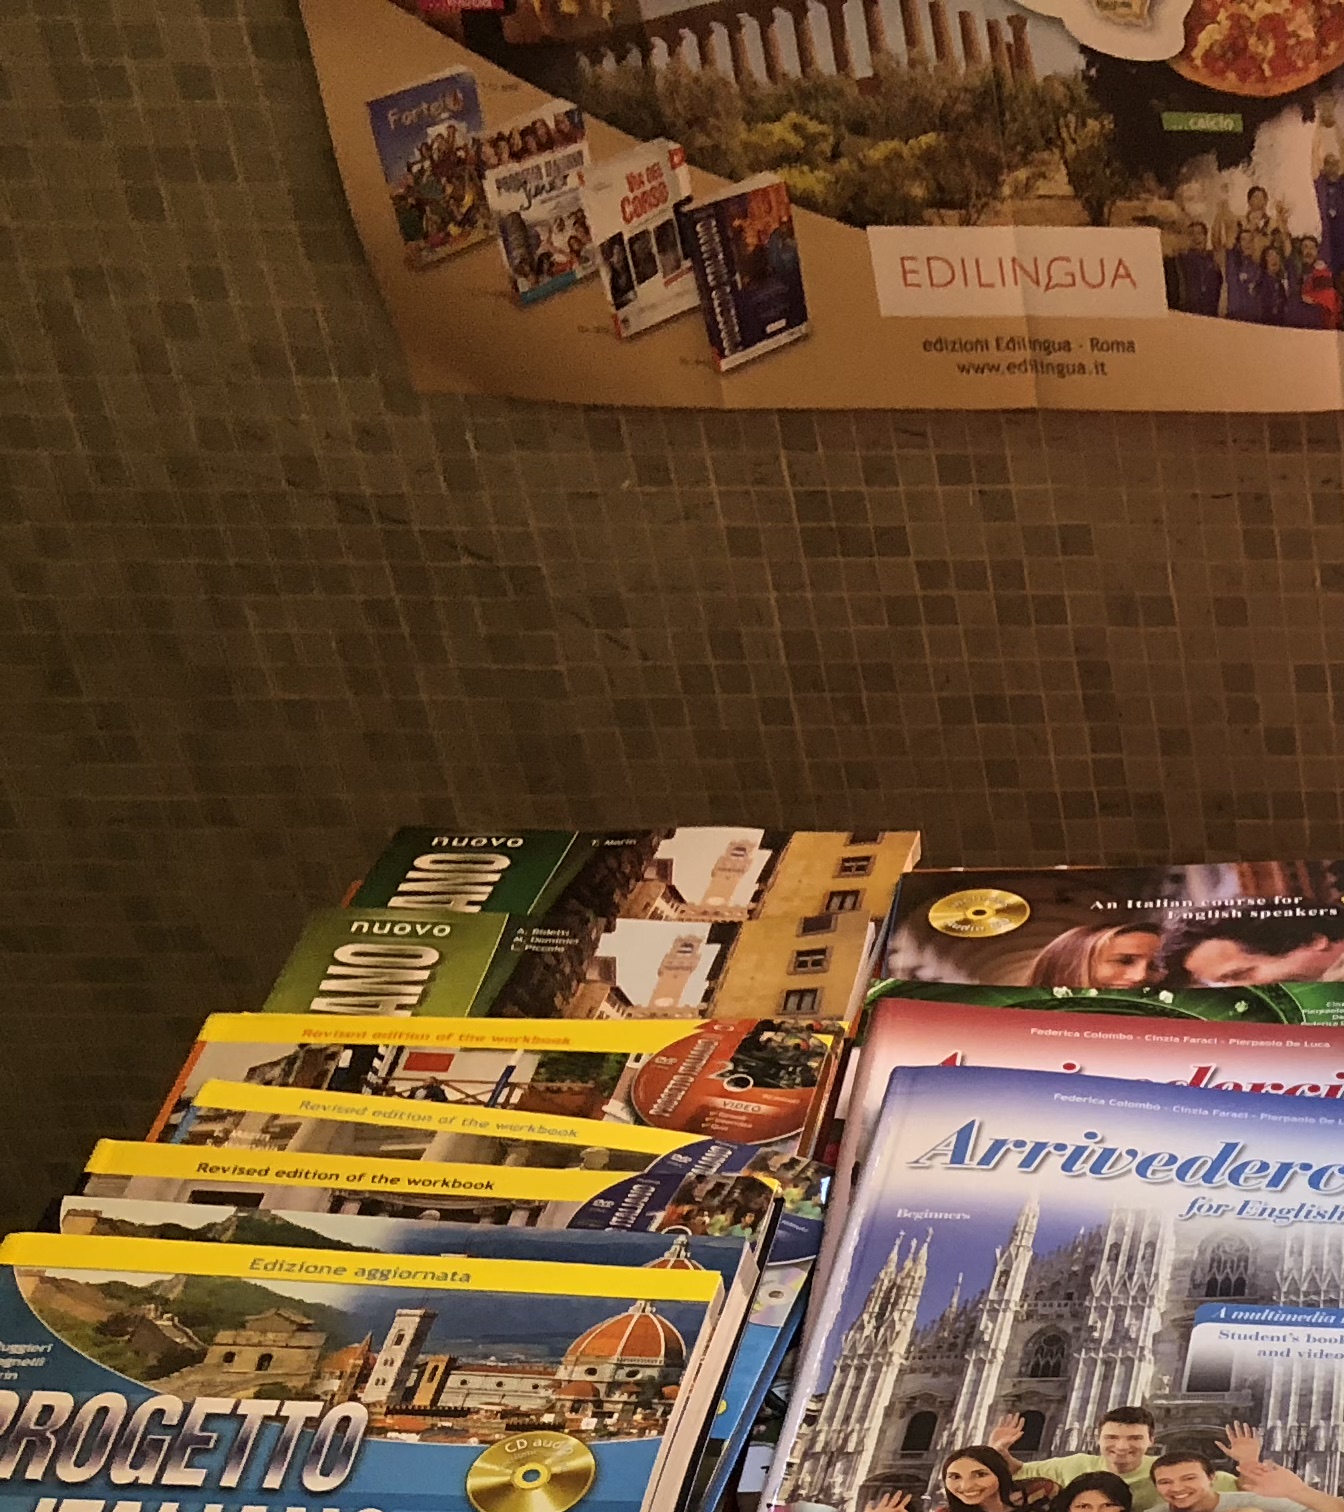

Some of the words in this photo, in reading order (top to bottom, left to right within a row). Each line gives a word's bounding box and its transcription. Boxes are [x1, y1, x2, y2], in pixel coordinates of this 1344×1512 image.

[900, 256, 1137, 292] EDILINGUA
[923, 337, 989, 353] edizioni
[995, 337, 1072, 355] Edilingua
[1090, 337, 1135, 354] Roma
[431, 835, 524, 848] nuovo
[1126, 896, 1191, 909] Italian
[1200, 896, 1268, 909] course
[1168, 907, 1245, 921] English
[1253, 906, 1337, 919] speakers
[350, 920, 452, 937] nuovo
[197, 1161, 271, 1180] Revised
[273, 1166, 340, 1184] edition
[345, 1168, 365, 1188] of
[369, 1172, 402, 1186] the
[406, 1176, 494, 1192] workbook
[1180, 1196, 1231, 1220] for
[248, 1256, 347, 1279] Edizione
[354, 1263, 471, 1285] aggiornata
[1231, 1309, 1336, 1327] multimedia
[1218, 1330, 1300, 1346] Student's
